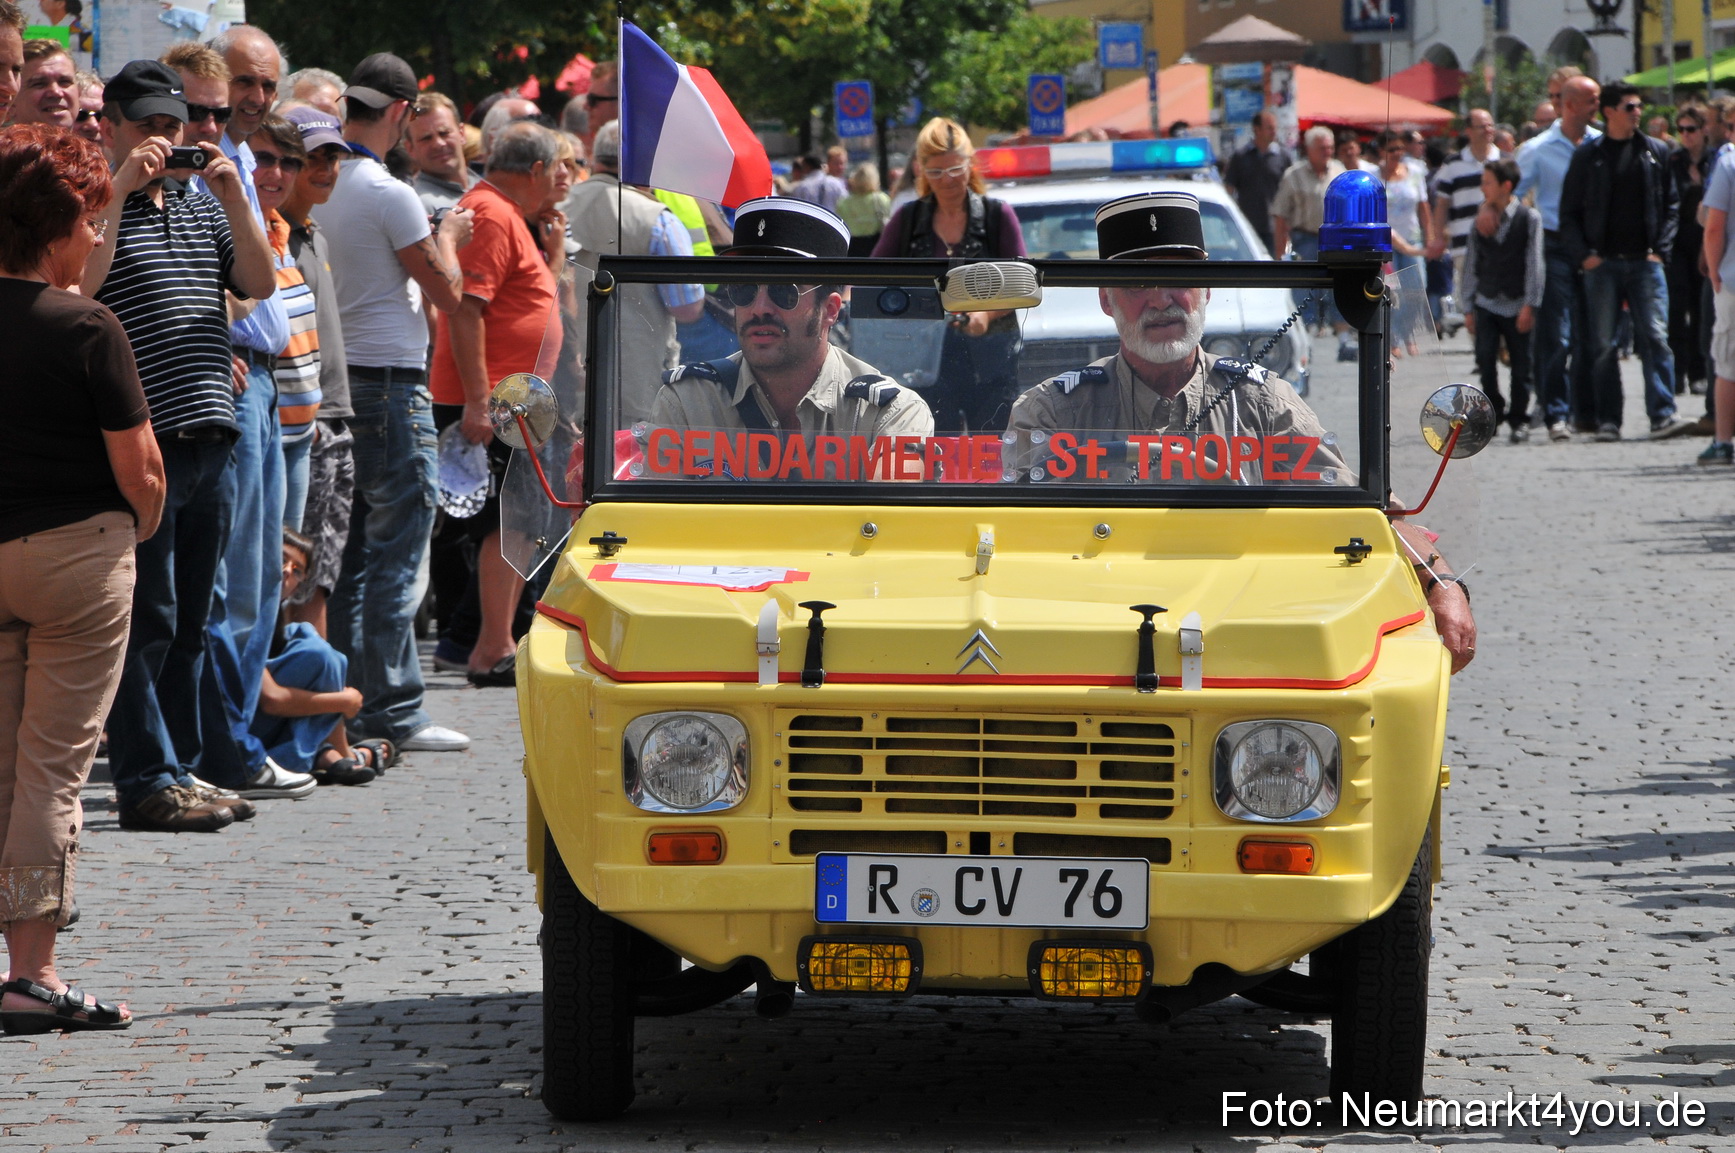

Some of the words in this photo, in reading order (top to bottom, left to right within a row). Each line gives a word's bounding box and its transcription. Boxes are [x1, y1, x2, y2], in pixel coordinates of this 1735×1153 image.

[647, 427, 999, 480] GENDARMERIE
[1046, 432, 1109, 479] St.
[1127, 433, 1321, 480] TROPEZ
[826, 895, 838, 909] D
[868, 864, 899, 914] R
[955, 866, 1022, 917] CV
[1059, 868, 1123, 918] 76
